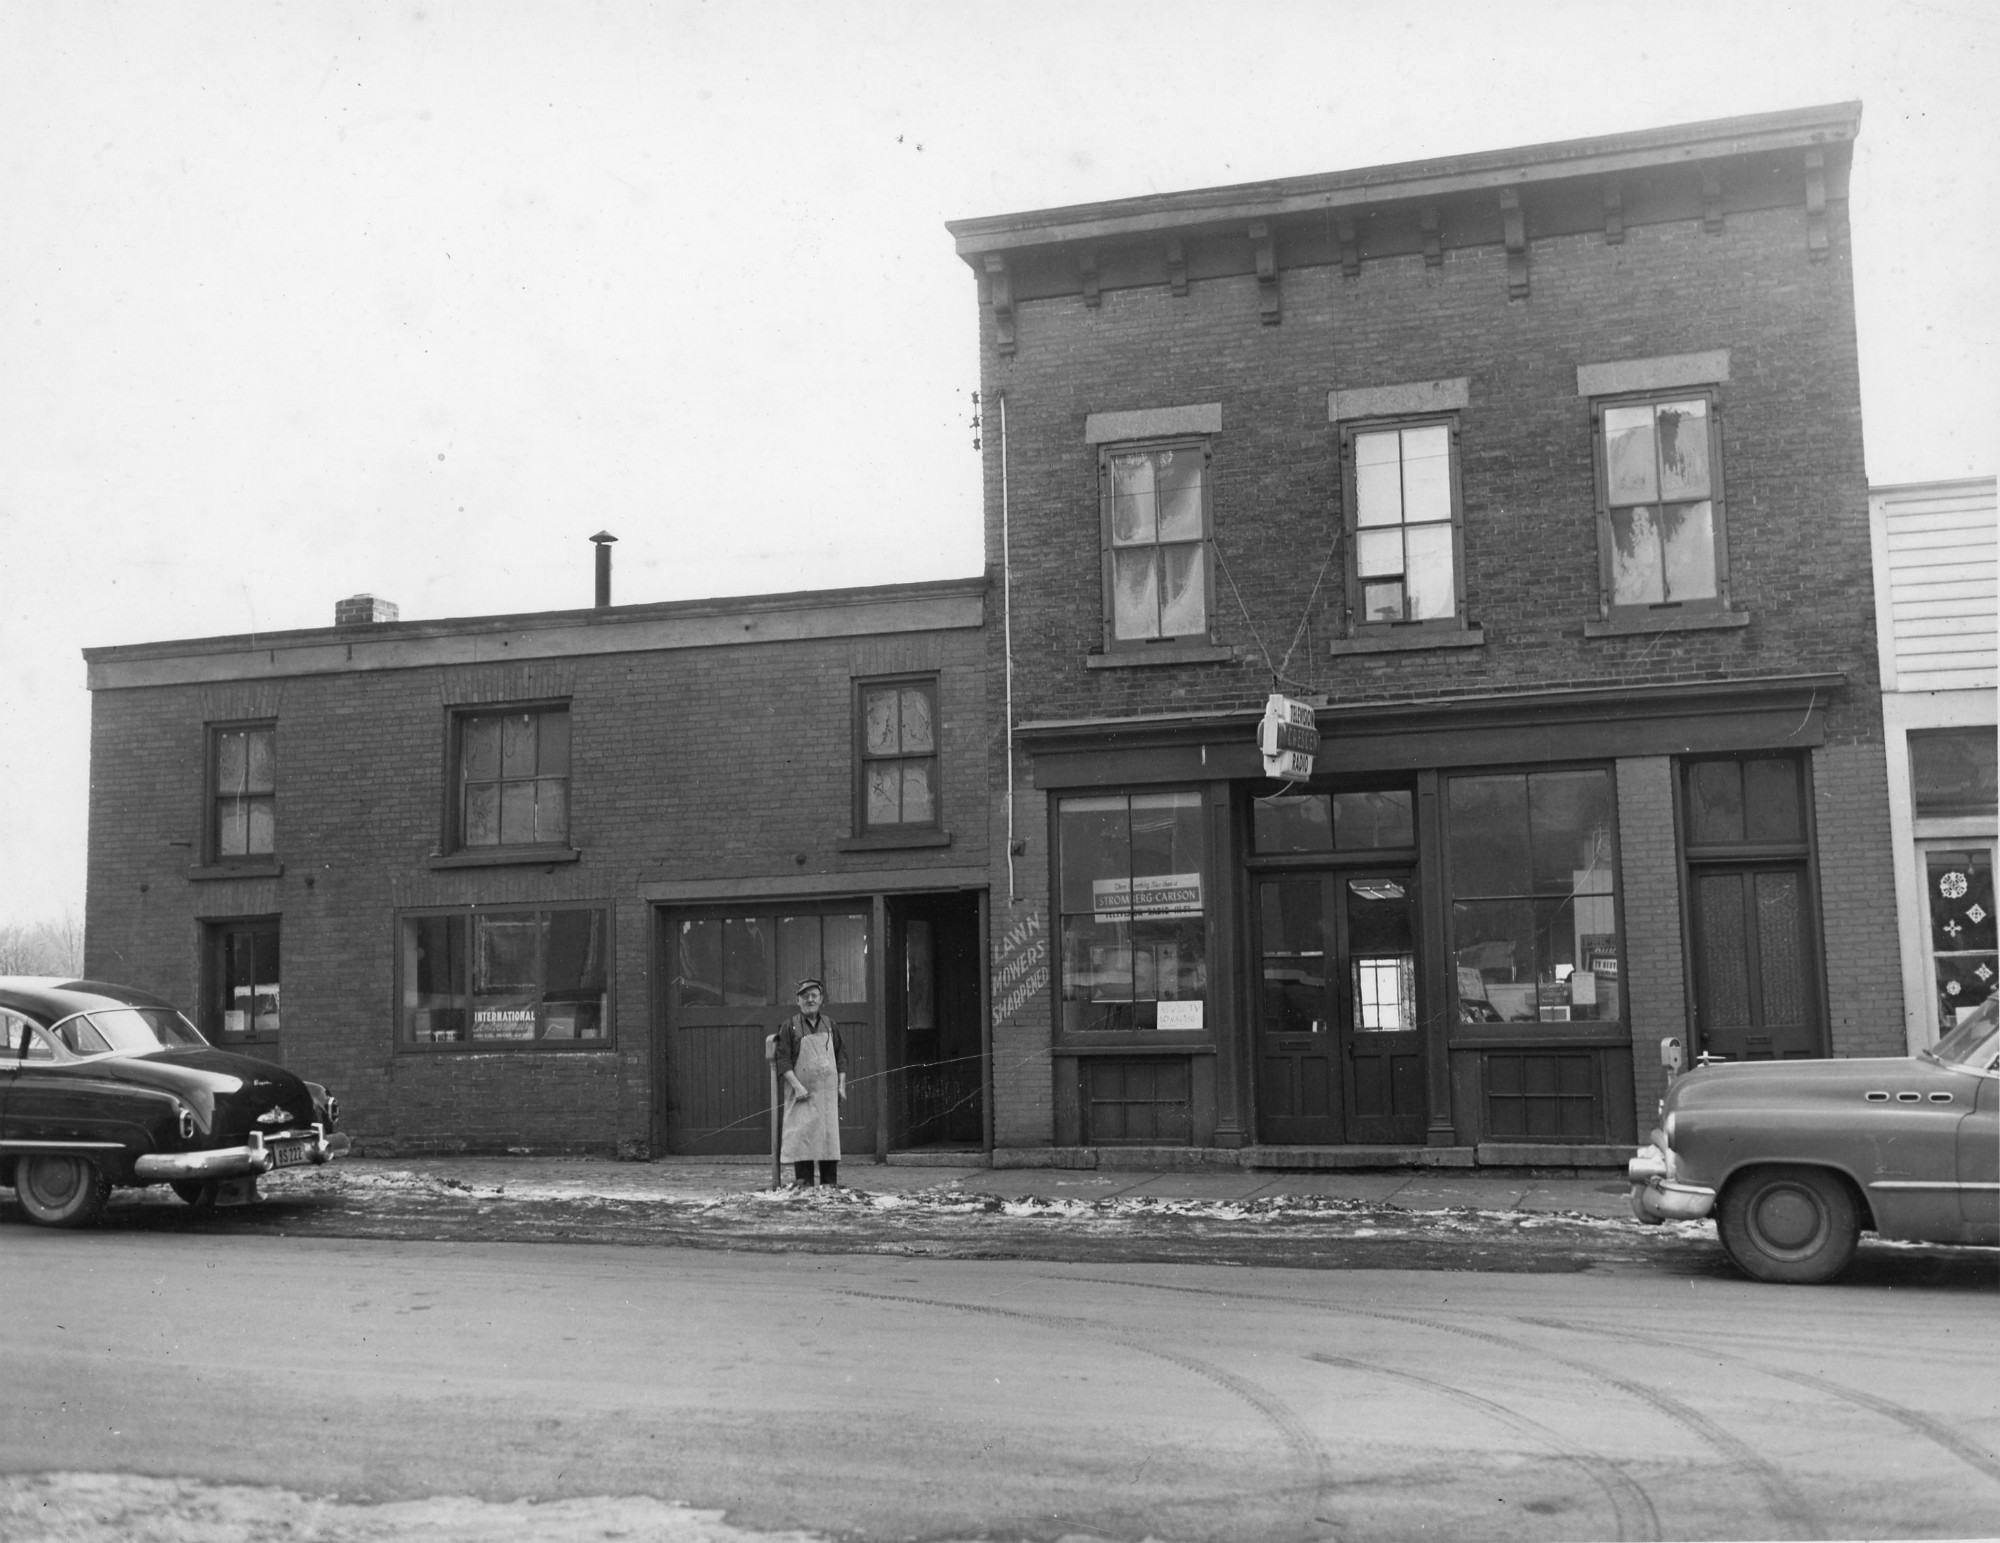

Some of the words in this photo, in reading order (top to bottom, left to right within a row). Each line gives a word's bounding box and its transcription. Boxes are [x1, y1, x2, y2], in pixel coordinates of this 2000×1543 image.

[1290, 705, 1315, 729] TELEVISION
[1288, 727, 1320, 751] CRESCENT
[1292, 753, 1308, 772] RADIO
[994, 911, 1041, 964] LAWN
[992, 940, 1045, 997] MOWERS
[992, 966, 1050, 1026] SHARPENED
[474, 1011, 535, 1022] INTERNATIONAL
